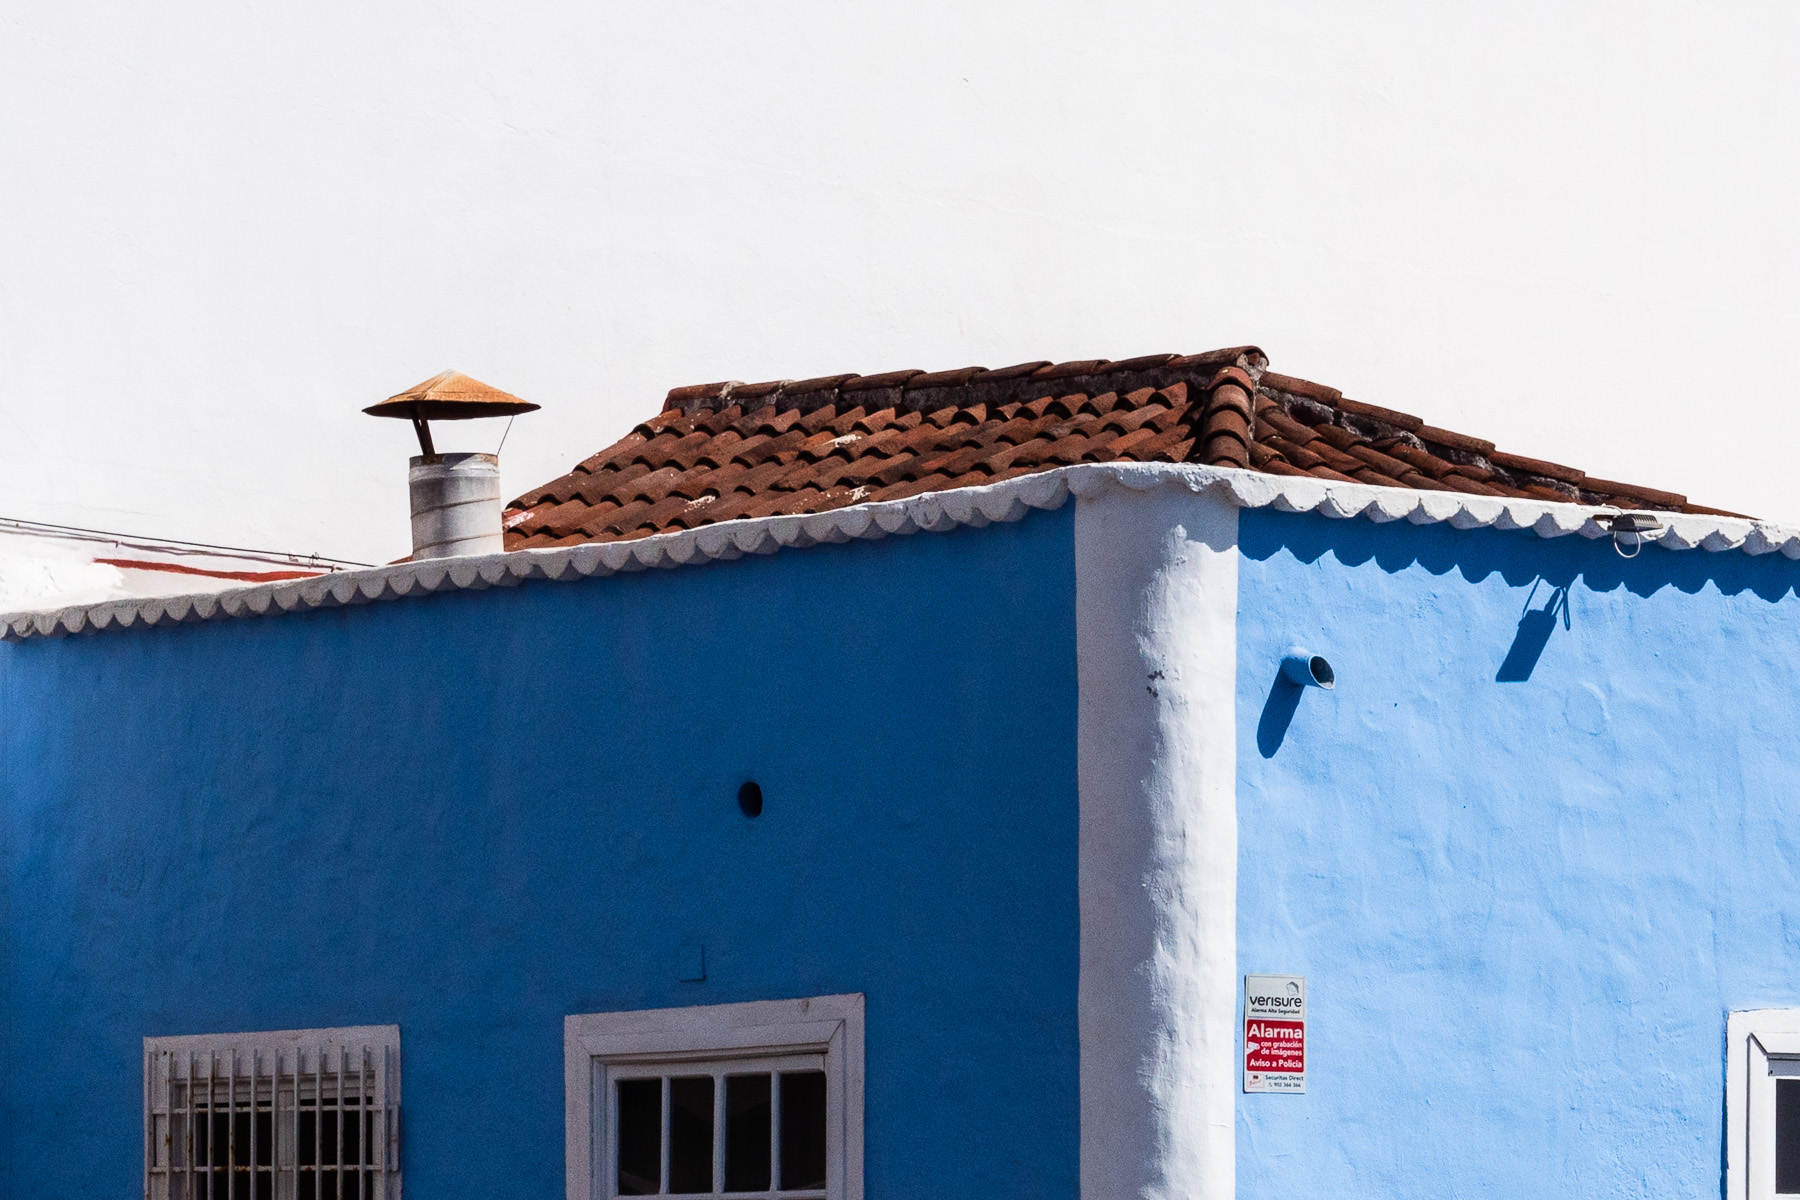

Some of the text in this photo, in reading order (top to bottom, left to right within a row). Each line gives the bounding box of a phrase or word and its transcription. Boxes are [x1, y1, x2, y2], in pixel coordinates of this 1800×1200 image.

[1249, 996, 1302, 1007] verisure
[1248, 1023, 1303, 1039] Alarma
[1260, 1047, 1270, 1055] de
[1250, 1059, 1270, 1067] Aviso
